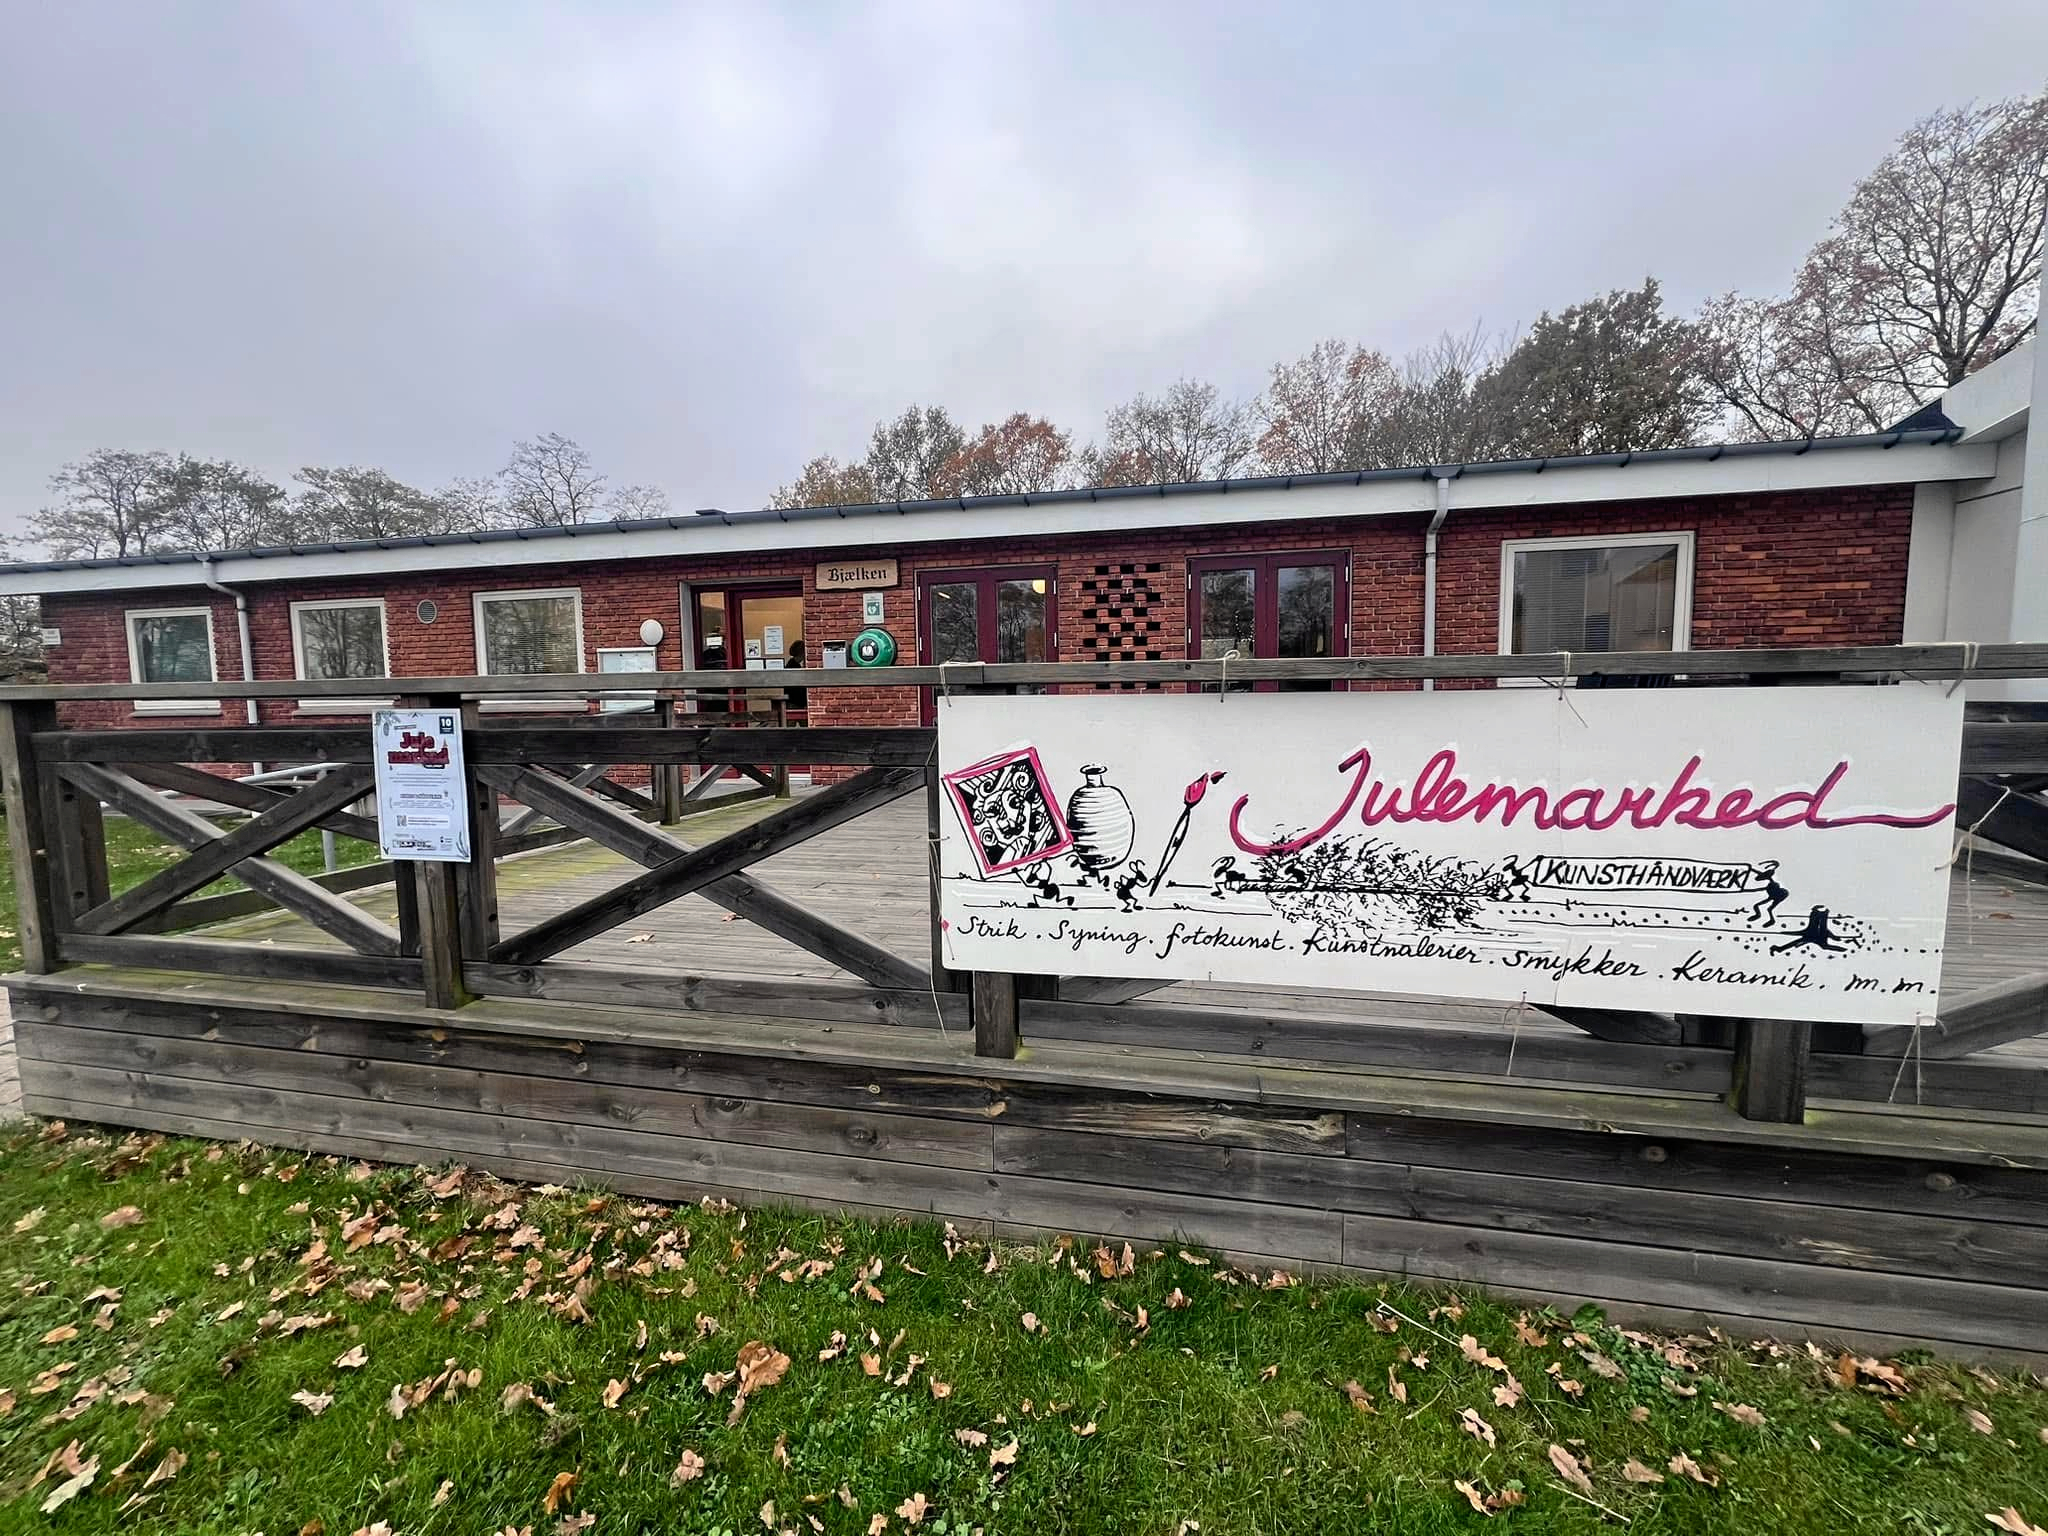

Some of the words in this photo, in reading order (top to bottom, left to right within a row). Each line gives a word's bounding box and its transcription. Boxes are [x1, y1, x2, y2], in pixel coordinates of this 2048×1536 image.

[827, 567, 888, 584] Bjælken
[440, 718, 452, 727] 10
[1230, 748, 1958, 856] Julemarked
[1540, 859, 1748, 889] KUNSTHÅNDVÆRK
